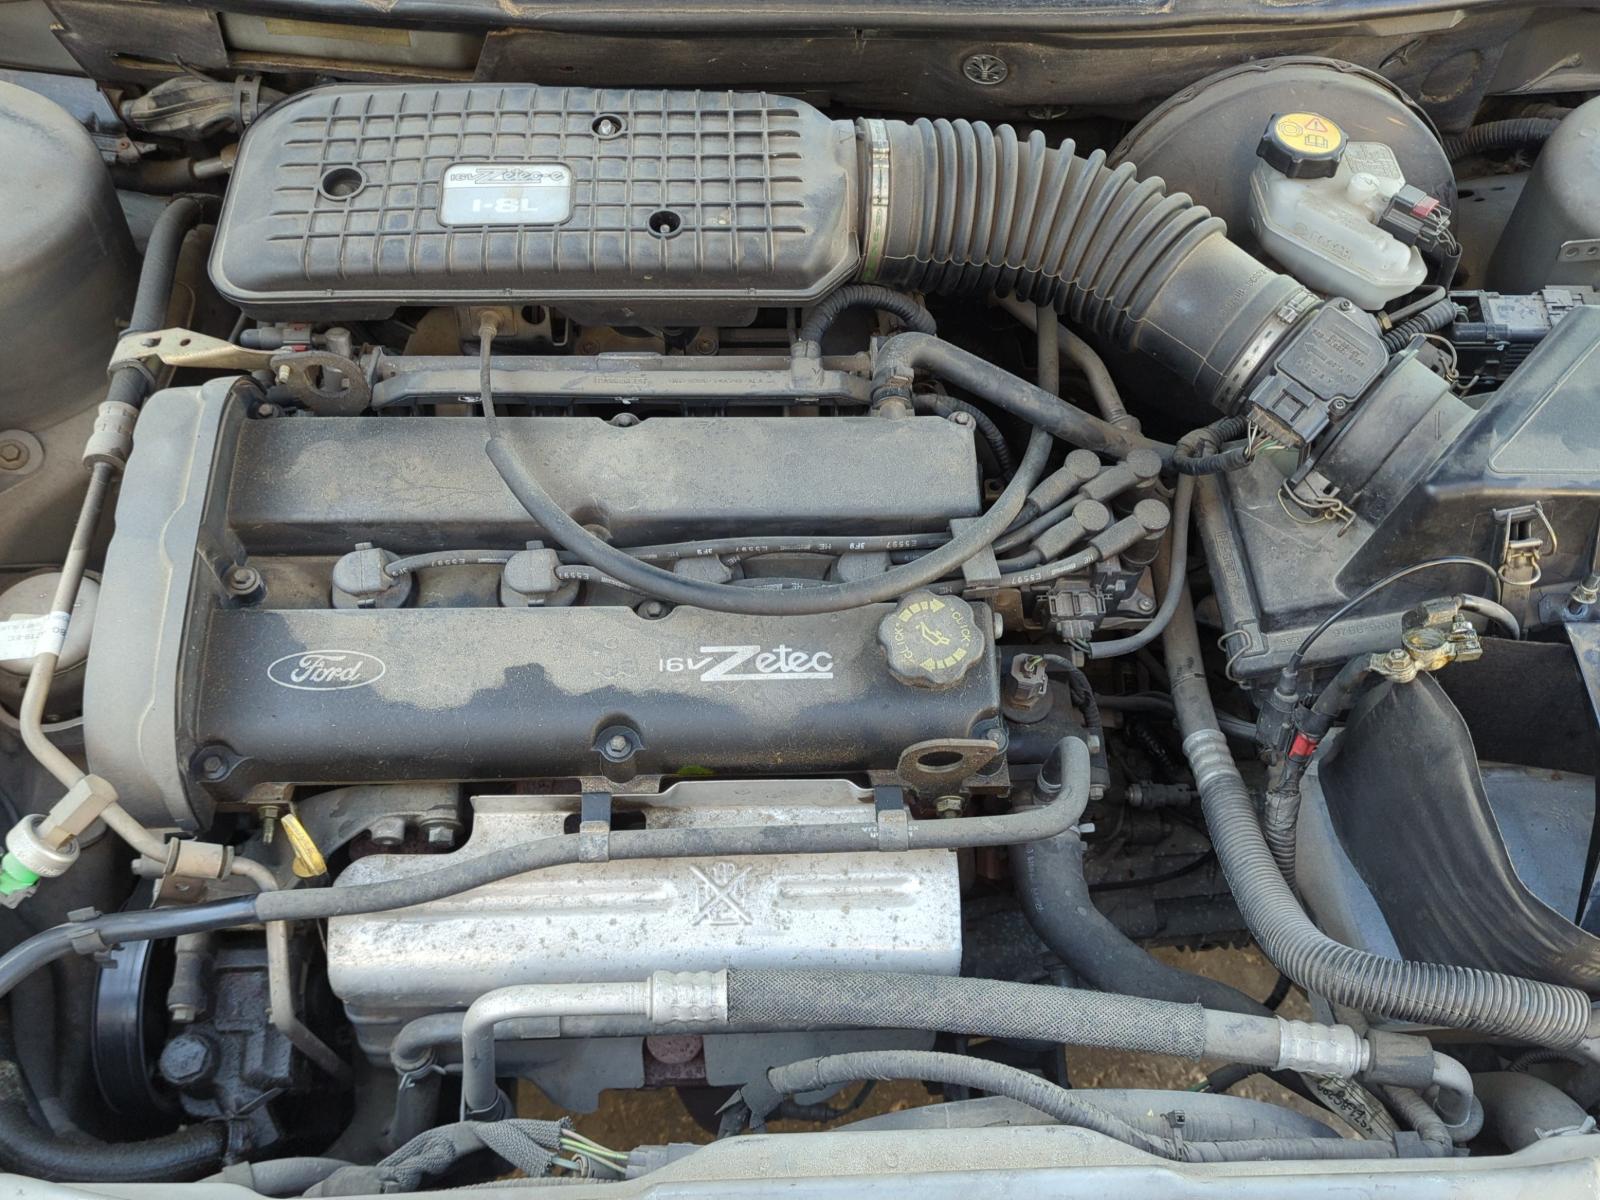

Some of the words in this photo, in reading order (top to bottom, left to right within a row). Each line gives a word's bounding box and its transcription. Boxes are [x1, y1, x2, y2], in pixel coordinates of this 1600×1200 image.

[290, 654, 364, 682] Ford
[657, 655, 714, 673] 16V
[699, 643, 835, 682] Zetec
